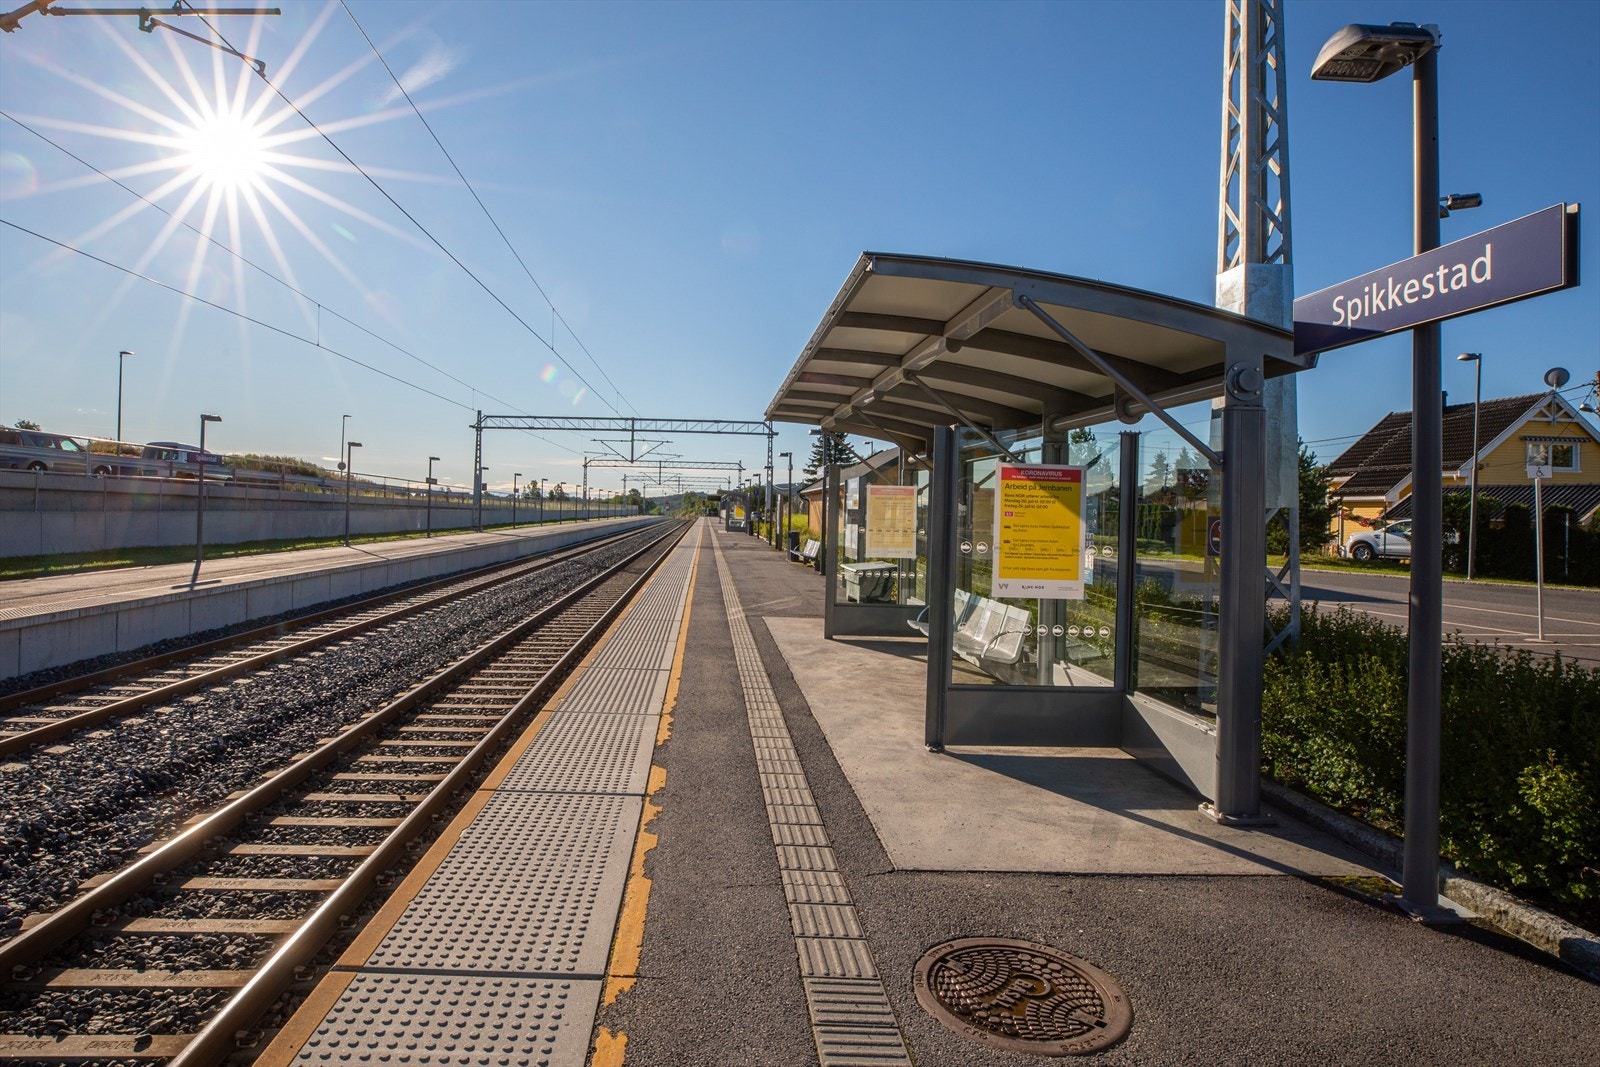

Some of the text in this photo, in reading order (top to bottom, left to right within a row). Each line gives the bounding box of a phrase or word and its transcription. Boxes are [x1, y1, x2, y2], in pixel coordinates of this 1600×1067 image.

[1332, 244, 1491, 329] Spikkestad
[1039, 484, 1073, 492] Jernbanen
[990, 978, 1034, 1007] BASAL
